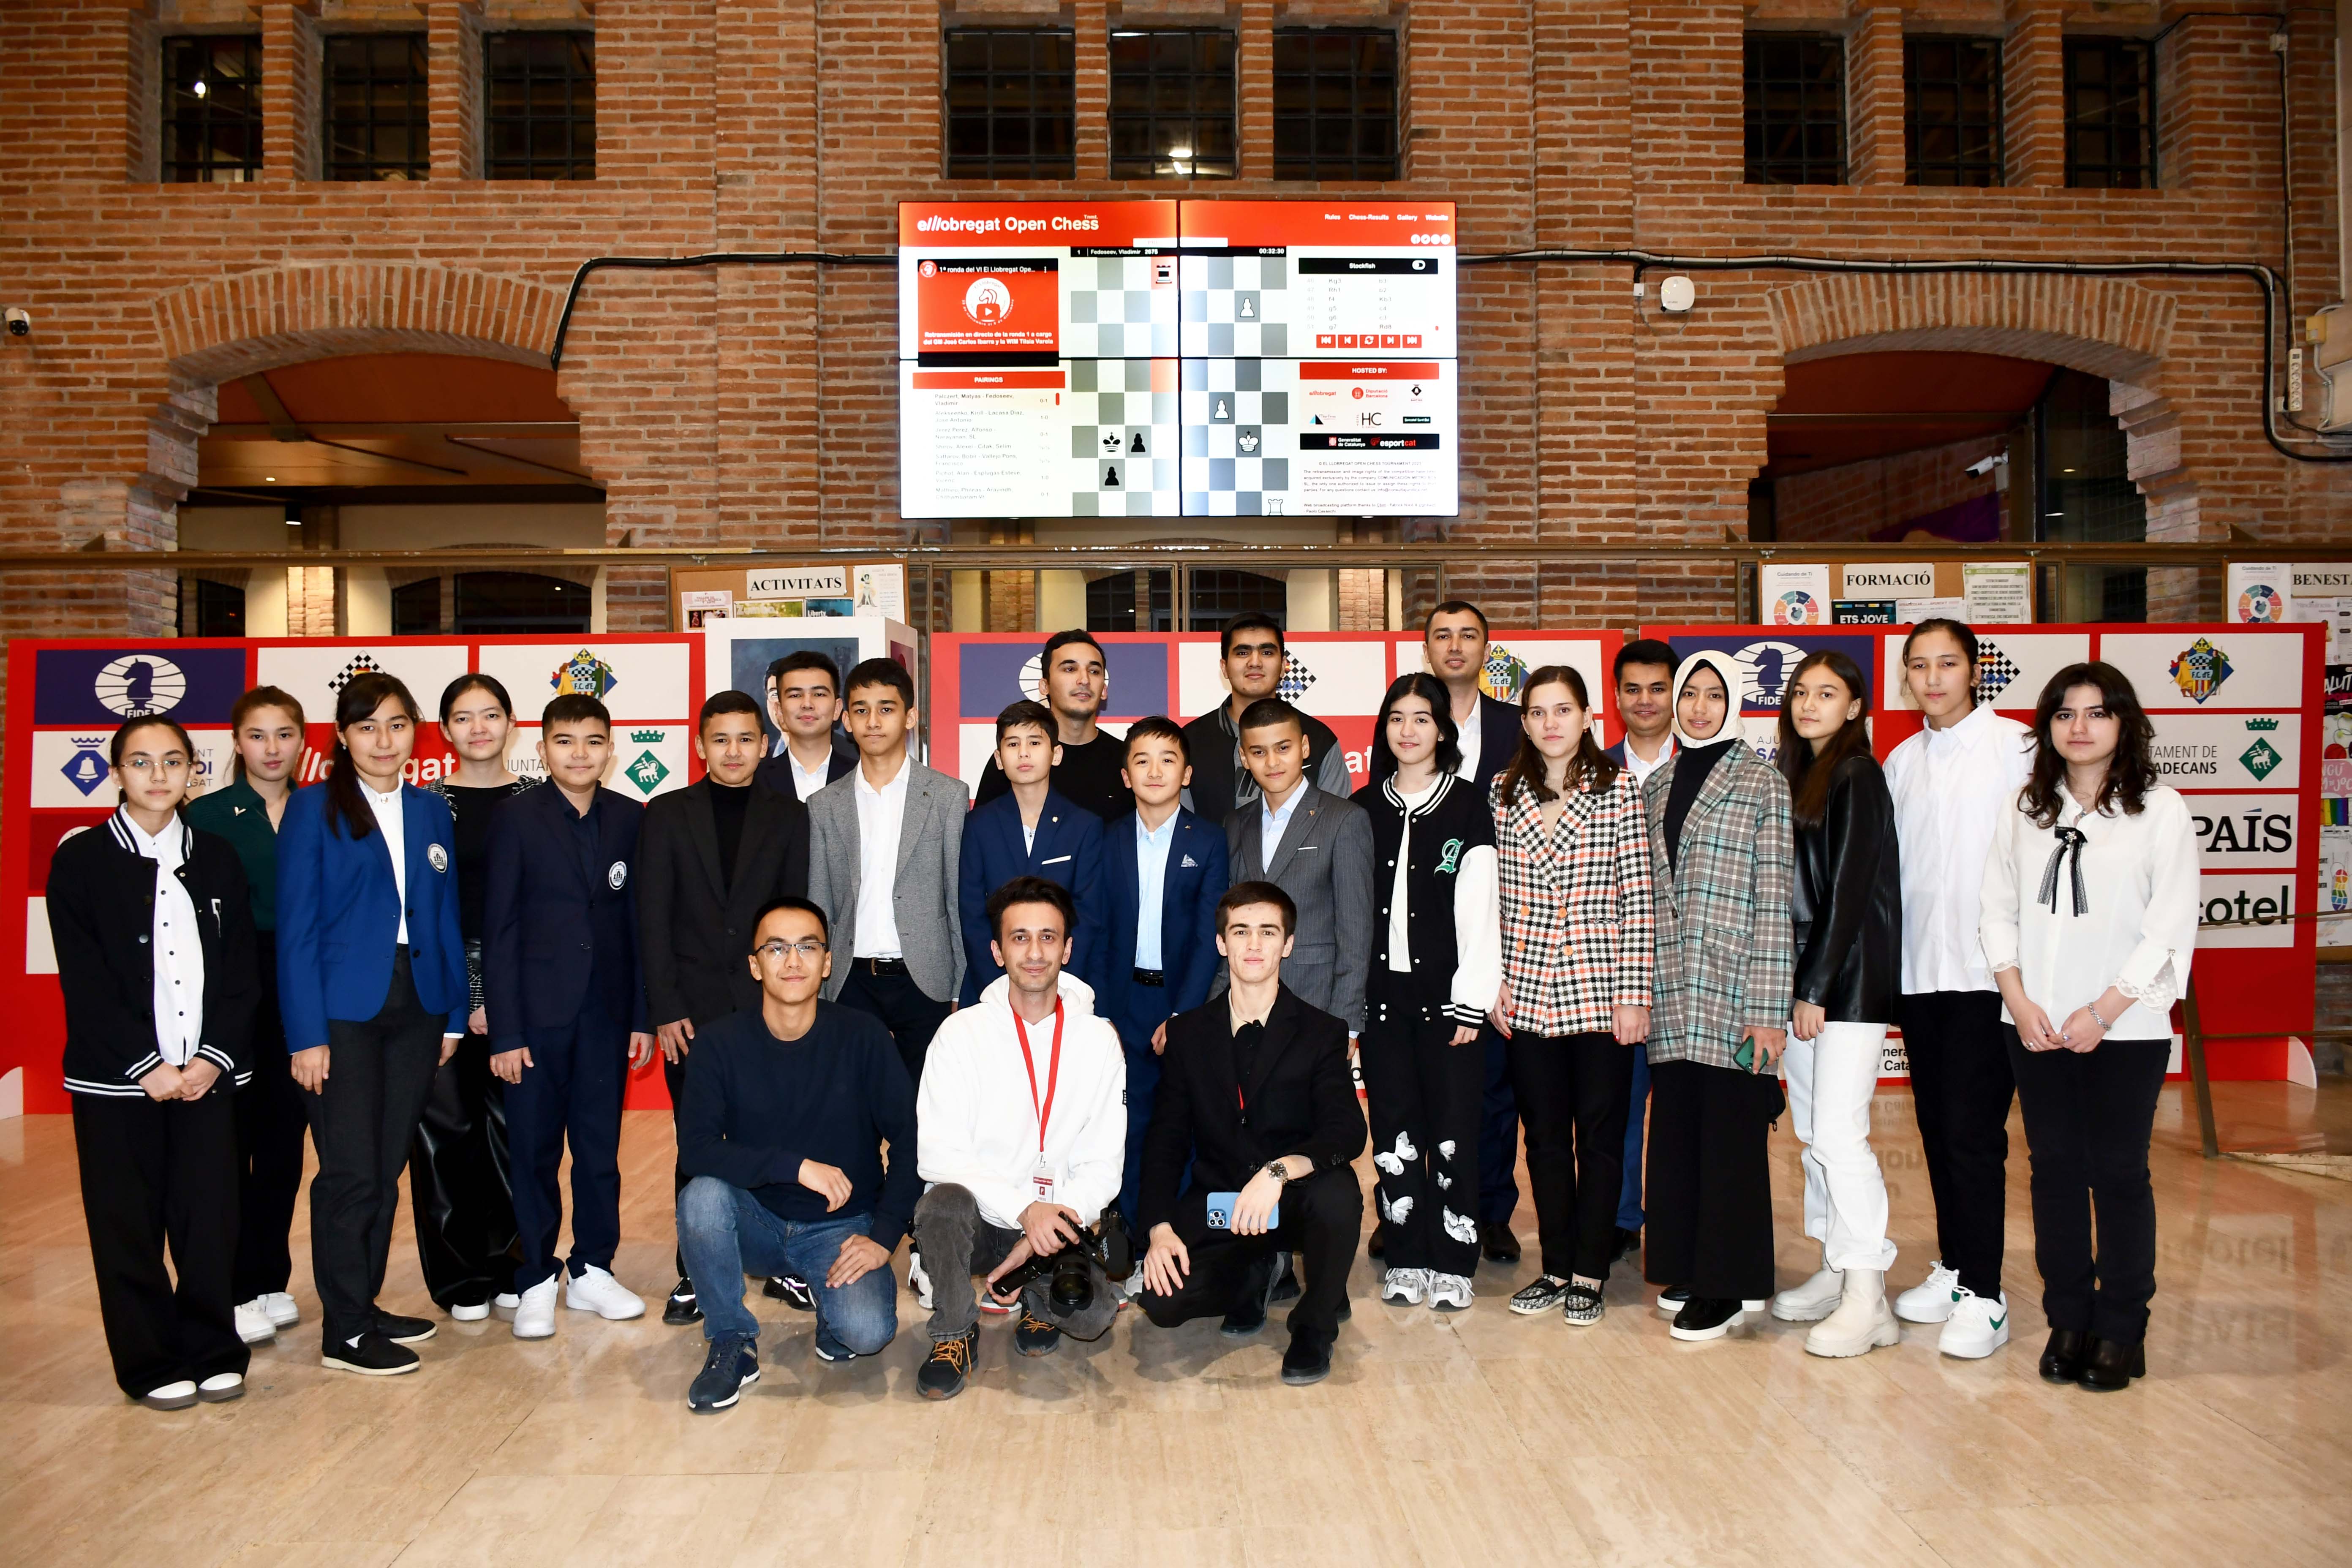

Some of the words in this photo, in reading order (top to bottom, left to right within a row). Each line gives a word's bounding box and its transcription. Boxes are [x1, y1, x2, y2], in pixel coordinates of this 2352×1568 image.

[1005, 217, 1046, 234] Open
[1051, 217, 1099, 230] Chess
[1362, 412, 1381, 426] HC
[1380, 439, 1416, 448] esportcat
[750, 577, 842, 591] ACTIVITATS
[1846, 571, 1931, 586] FORMACIÓ
[1840, 615, 1859, 624] ETS
[1860, 614, 1888, 624] JOVE
[1758, 696, 1781, 705] FIDE
[1757, 736, 1780, 744] AJU
[1756, 747, 1777, 761] SA
[2149, 746, 2198, 758] TAMENT
[2202, 746, 2217, 757] DE
[1345, 746, 1372, 773] at
[2156, 762, 2217, 774] ADECANS
[1883, 1048, 1908, 1057] nera
[1884, 1060, 1910, 1071] Cata
